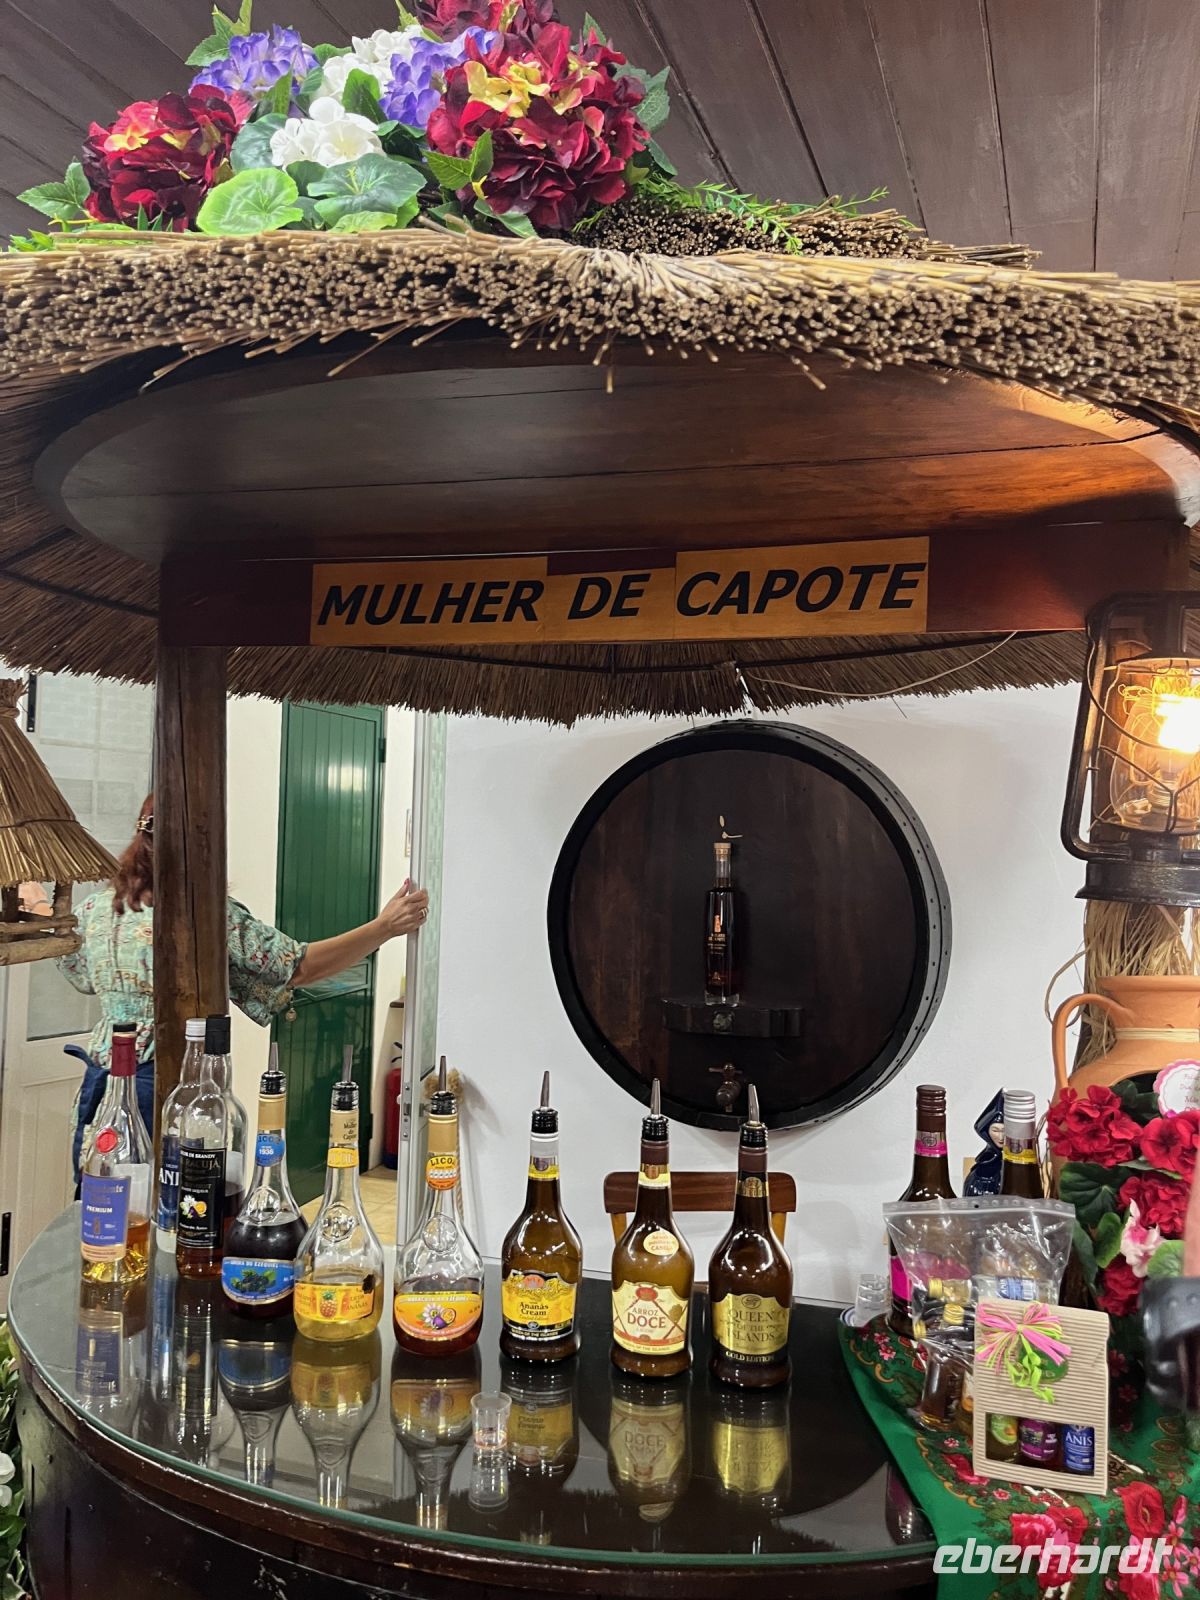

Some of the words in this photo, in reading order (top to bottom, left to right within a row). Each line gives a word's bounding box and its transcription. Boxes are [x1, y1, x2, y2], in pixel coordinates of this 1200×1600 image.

[318, 581, 545, 626] MULHER
[567, 573, 651, 620] DE
[675, 562, 927, 616] CAPOTE
[159, 1167, 180, 1186] ANI
[86, 1204, 113, 1213] PREMIUM
[521, 1308, 547, 1316] Cream
[632, 1307, 659, 1316] ARROZ
[729, 1310, 775, 1323] QUEEN
[627, 1312, 667, 1328] DOCE
[727, 1327, 775, 1342] ISLANDS
[725, 1350, 745, 1361] GOLD
[1065, 1431, 1093, 1446] ANIS
